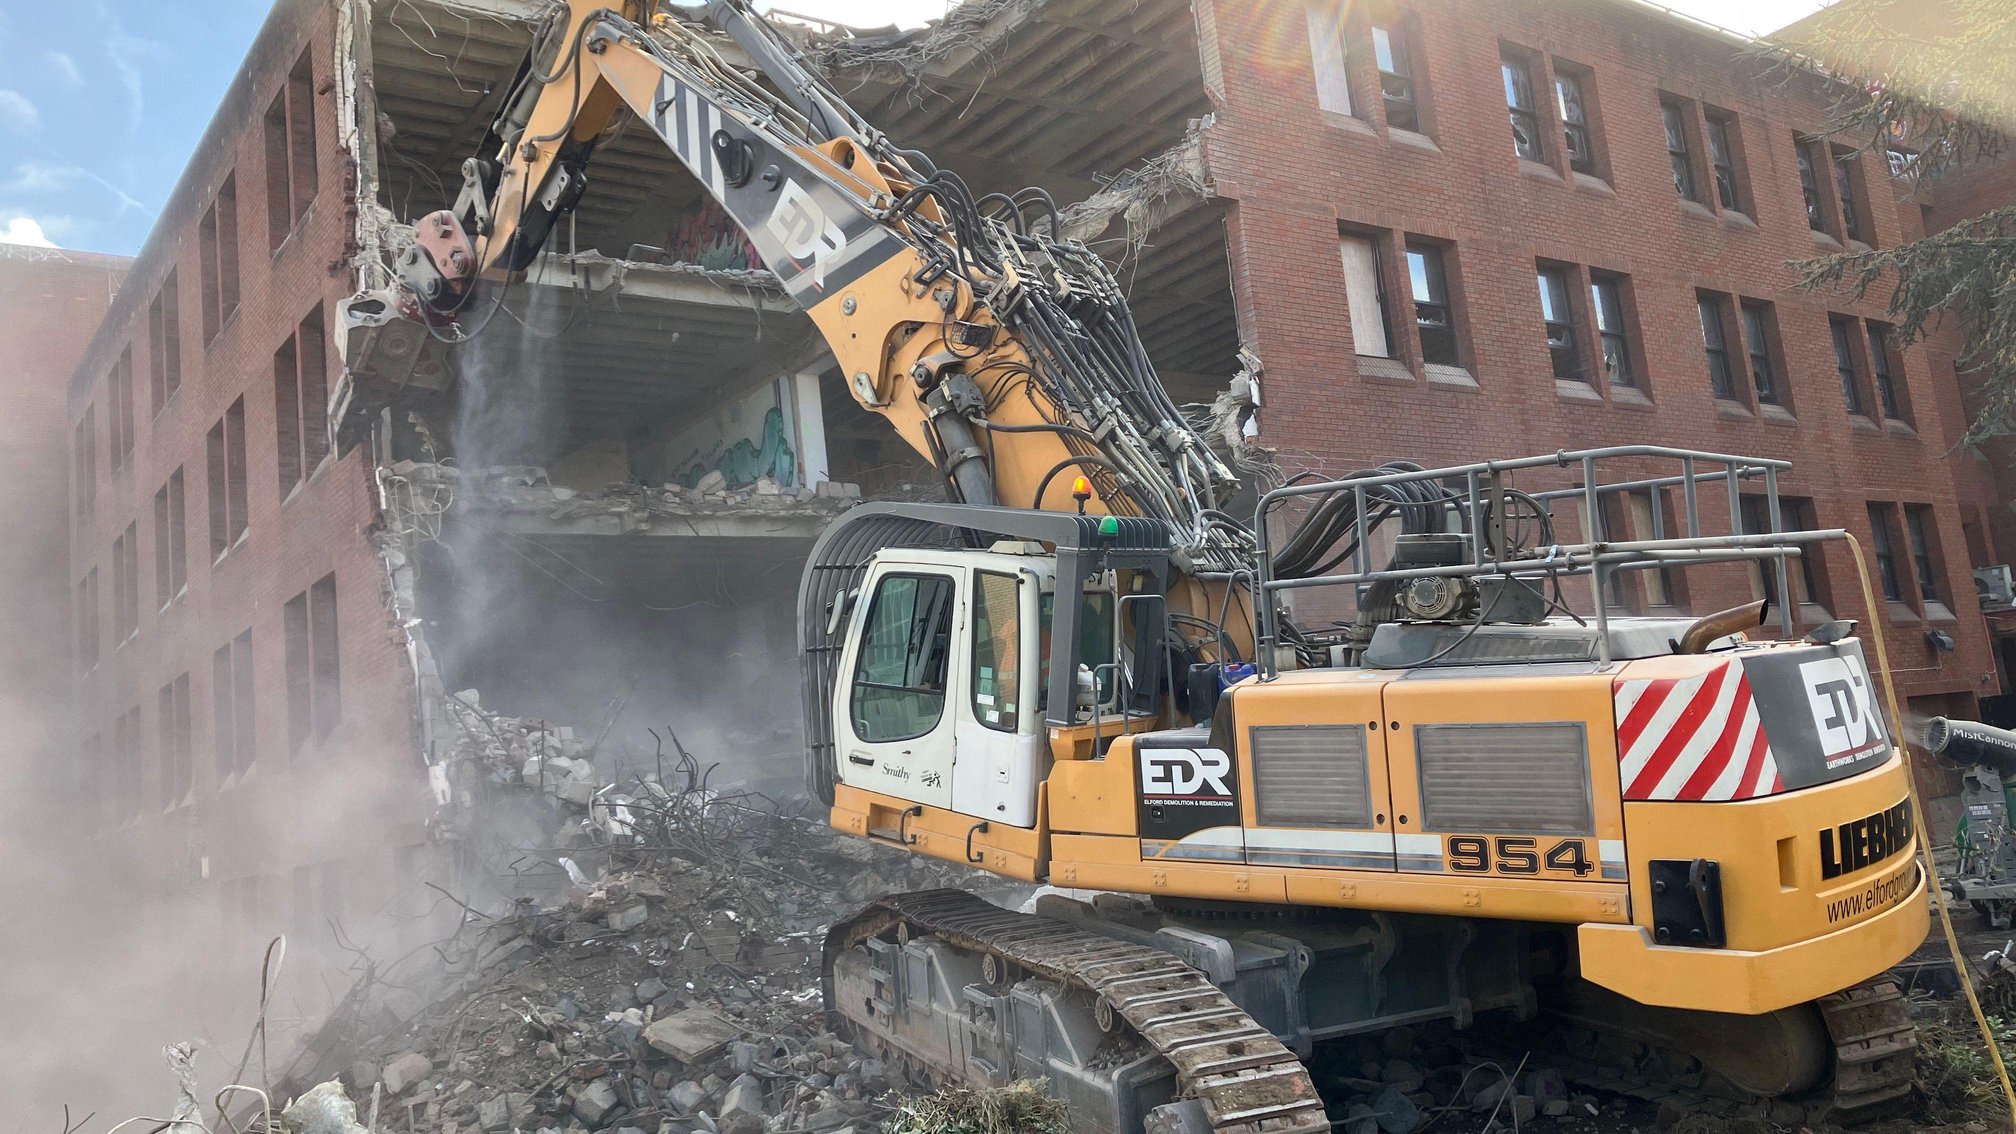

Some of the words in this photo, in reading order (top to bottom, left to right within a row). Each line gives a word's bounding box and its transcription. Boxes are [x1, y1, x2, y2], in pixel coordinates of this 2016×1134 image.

[766, 177, 847, 288] EDR
[1799, 655, 1883, 757] EDR
[1953, 728, 2016, 750] MistCannon
[881, 762, 912, 784] Smithy
[1140, 748, 1233, 796] EDR
[1826, 755, 1855, 770] EARTHWORKS
[1447, 835, 1595, 877] 954
